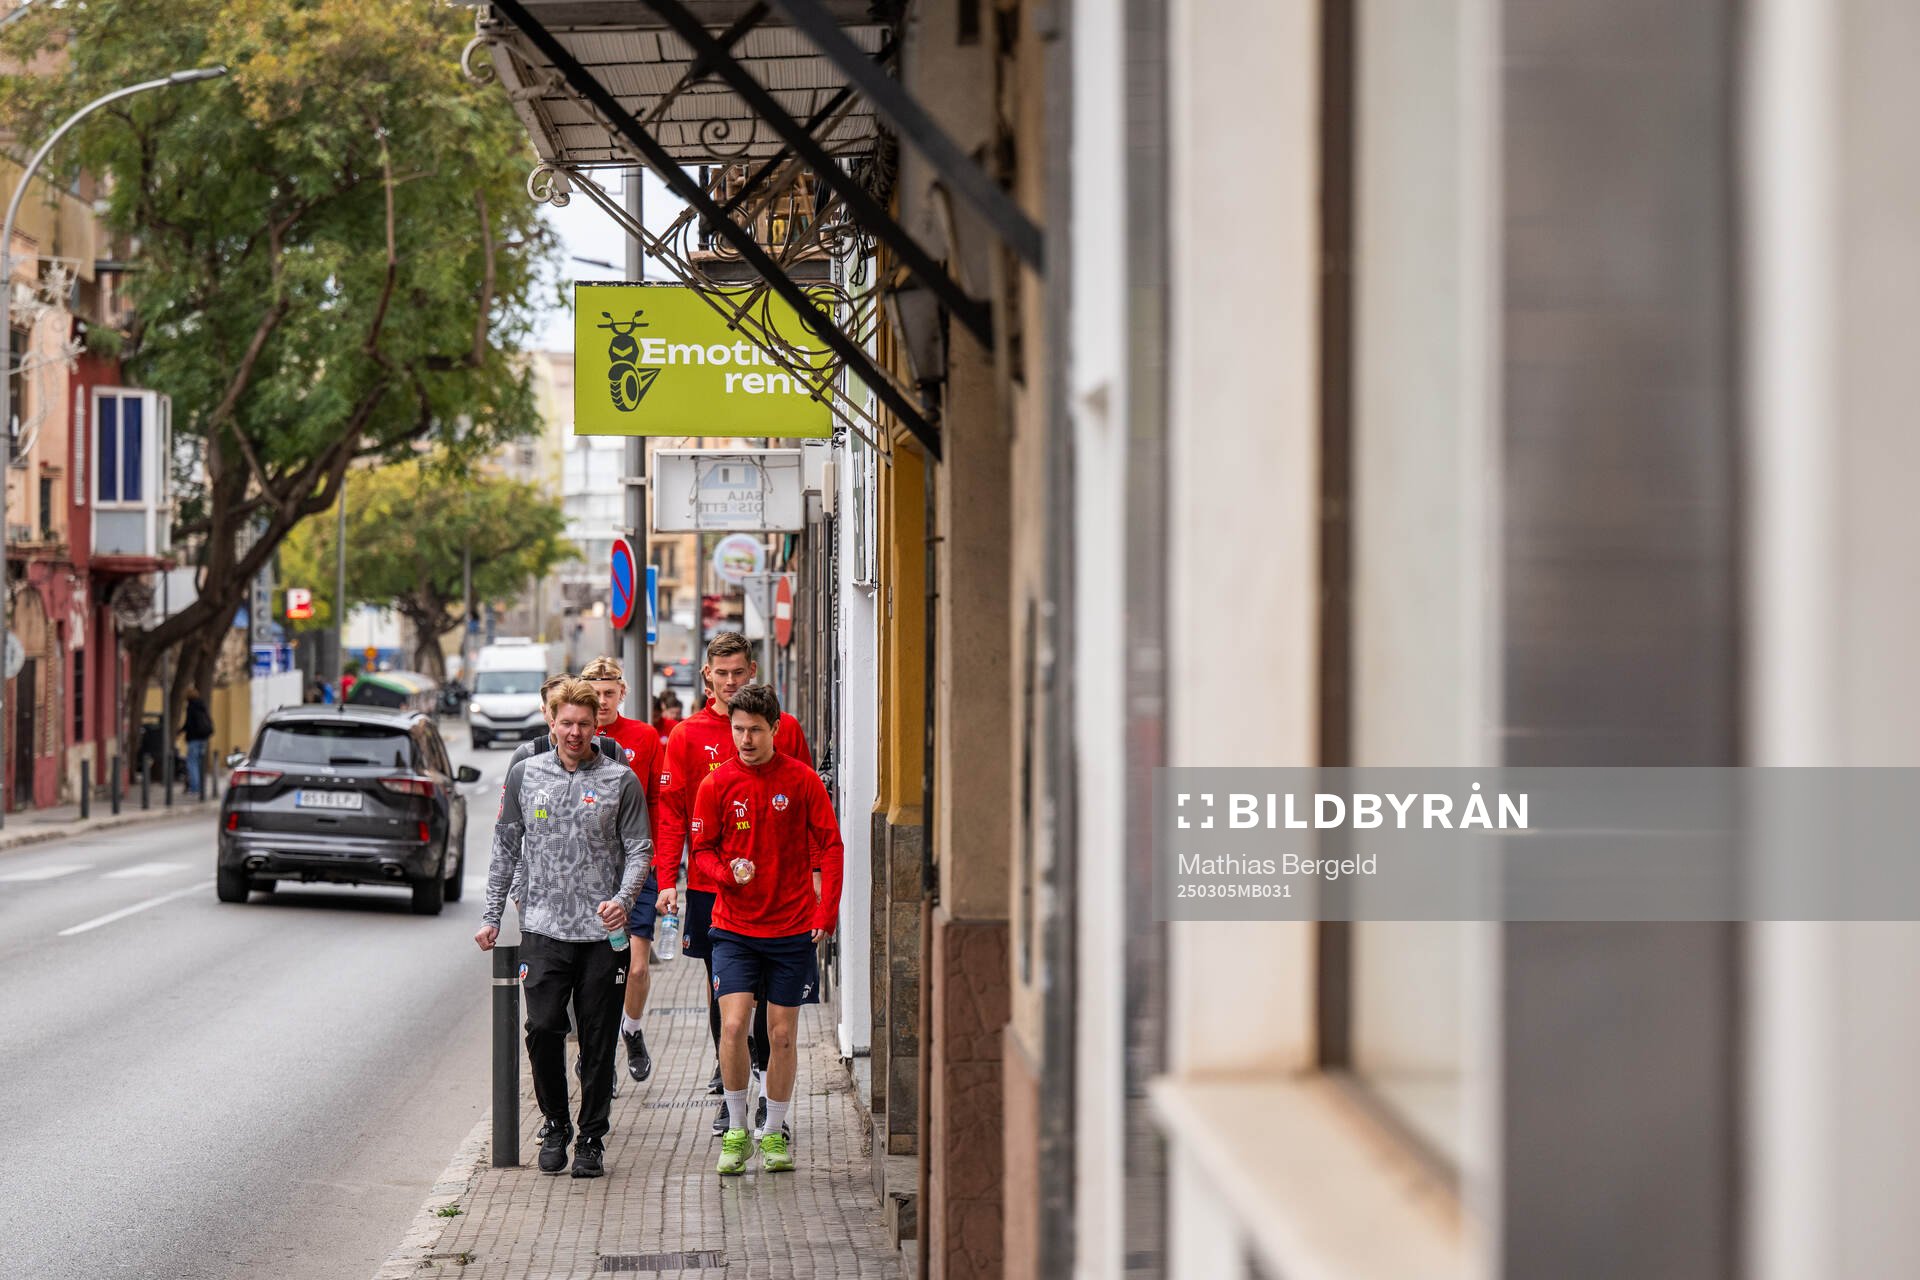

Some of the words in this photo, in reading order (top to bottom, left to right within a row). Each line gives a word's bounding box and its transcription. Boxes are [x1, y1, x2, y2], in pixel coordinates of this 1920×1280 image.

[725, 367, 811, 395] rent
[735, 808, 745, 818] 10
[736, 820, 751, 831] XXL
